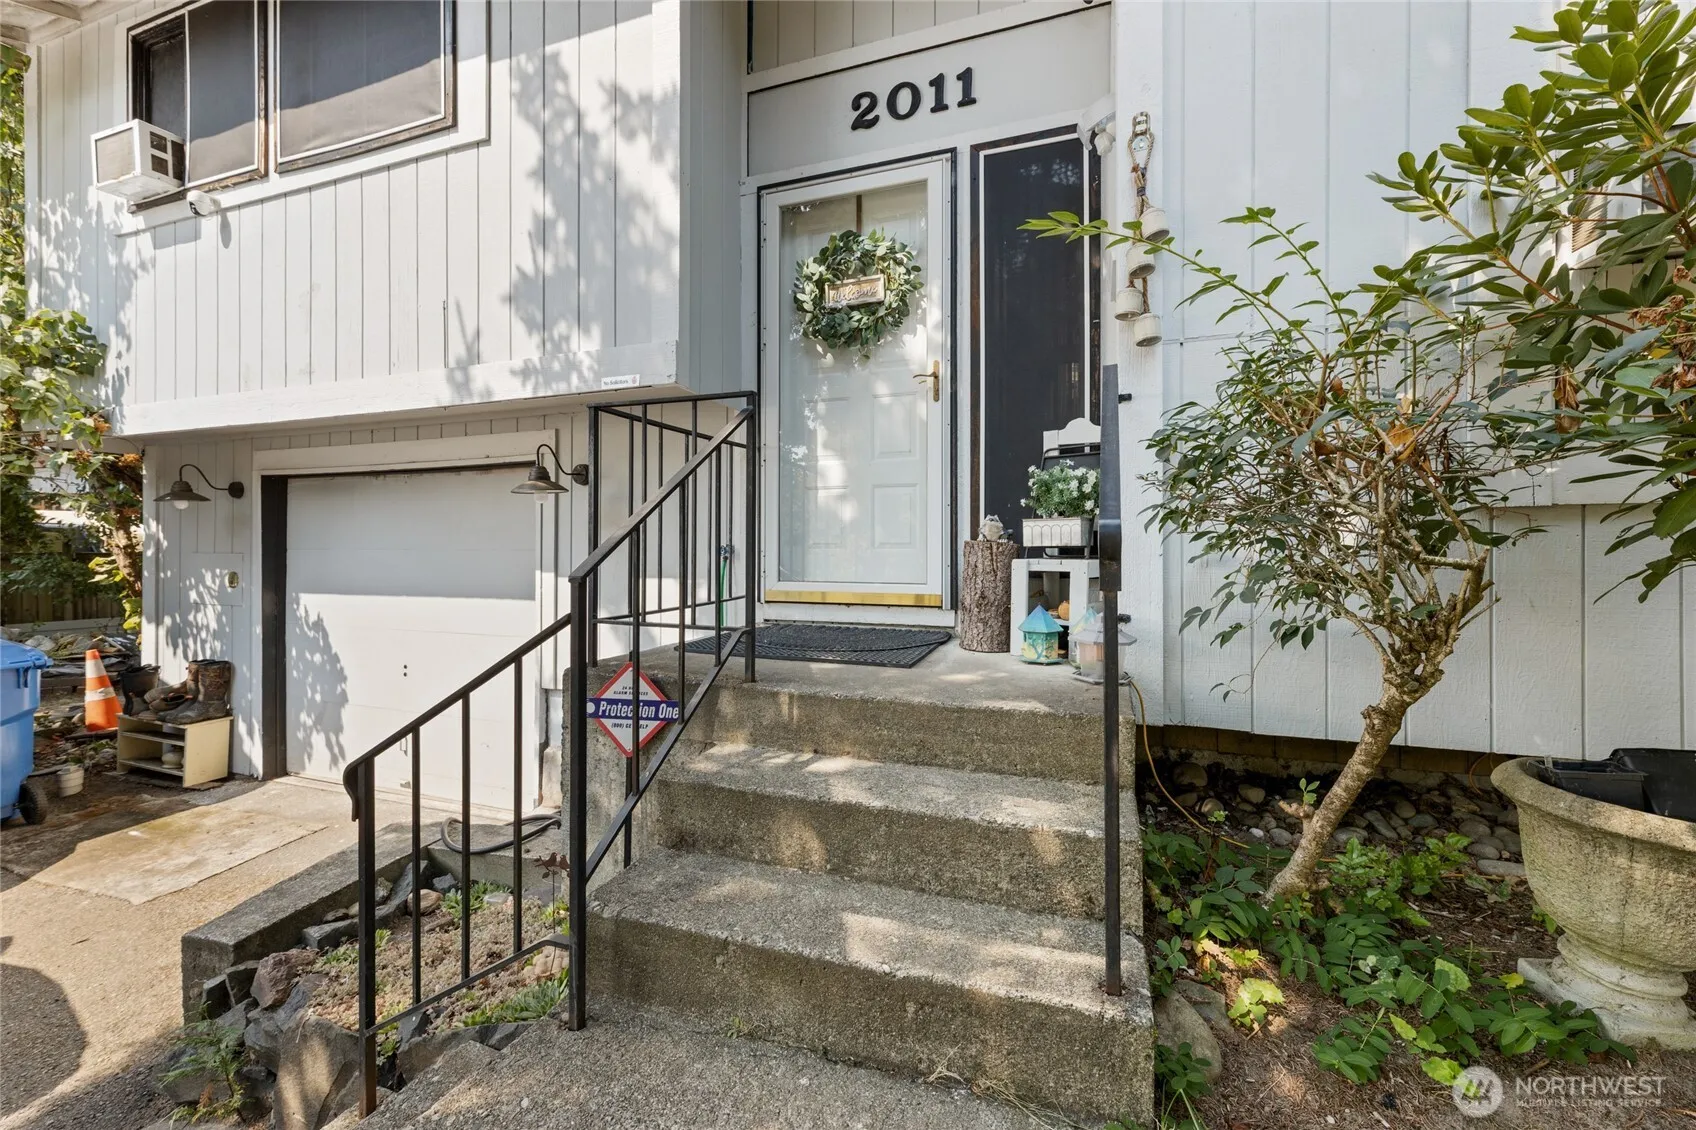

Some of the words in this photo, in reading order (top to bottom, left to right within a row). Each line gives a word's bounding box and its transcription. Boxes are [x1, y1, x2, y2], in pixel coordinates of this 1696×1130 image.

[851, 66, 977, 131] 2011
[599, 701, 656, 718] Protecion
[658, 703, 679, 719] One
